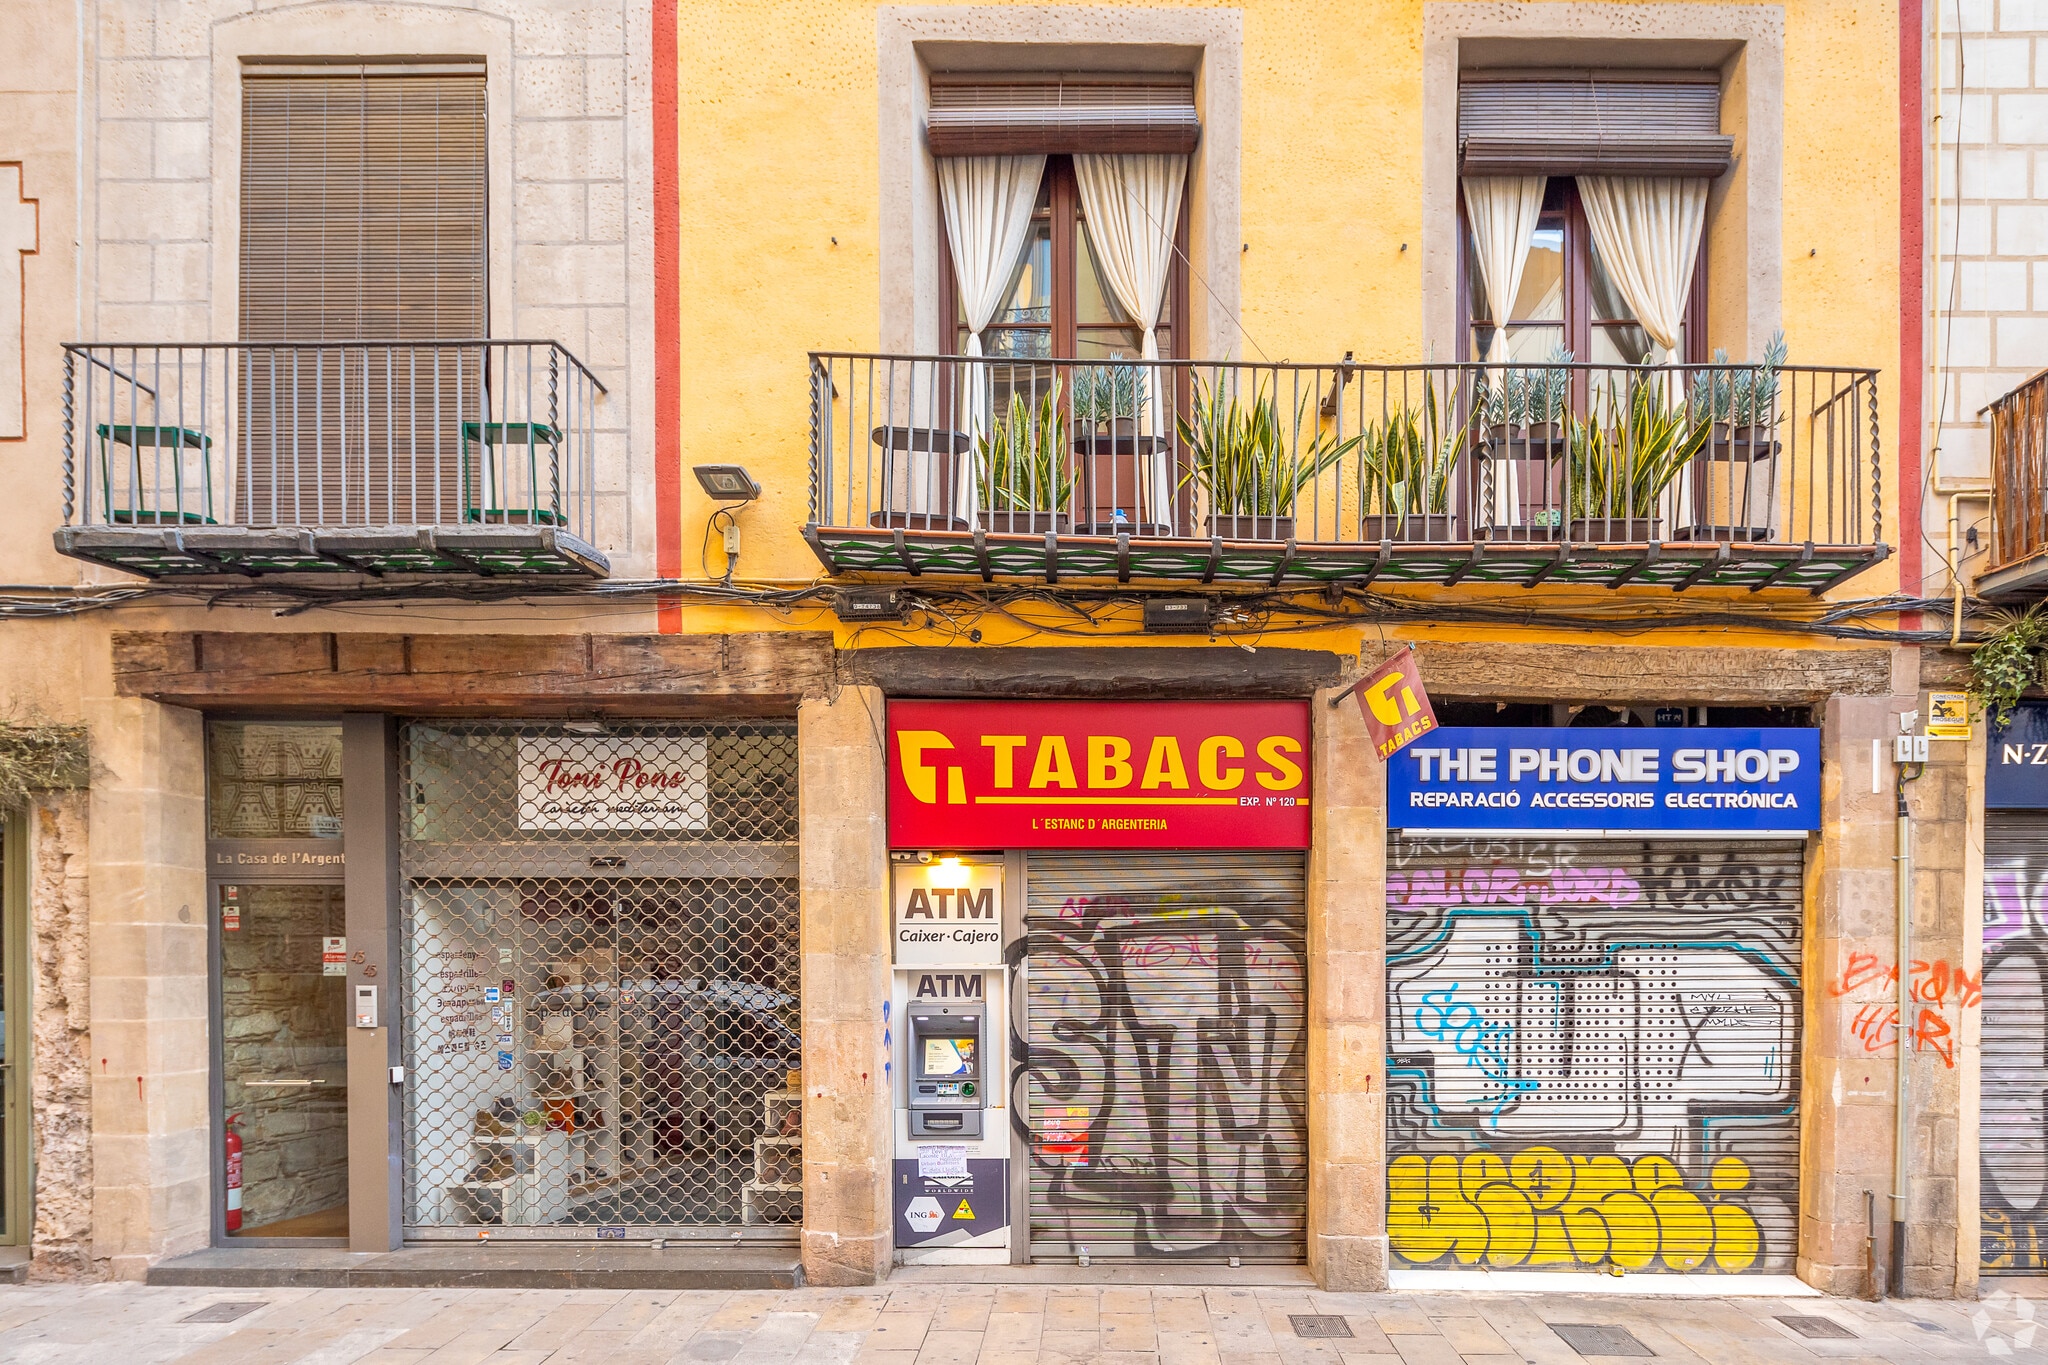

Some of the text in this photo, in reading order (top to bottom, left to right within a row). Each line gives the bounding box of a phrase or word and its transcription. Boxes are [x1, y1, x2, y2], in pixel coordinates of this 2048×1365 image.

[1380, 716, 1432, 756] TABACS
[540, 758, 686, 794] Toni Pons
[980, 735, 1303, 791] TABACS
[1410, 748, 1800, 784] THE PHONE SHOP
[1240, 797, 1260, 806] EXP.
[1279, 797, 1294, 806] 120
[1410, 790, 1798, 808] REPARACIÓ ACCESSORIS ELECTRÓNICA
[216, 853, 232, 864] La
[238, 853, 268, 864] Casa
[272, 852, 287, 864] de
[904, 888, 994, 918] ATM
[900, 930, 998, 944] Caixer Cajero
[916, 974, 982, 997] ATM
